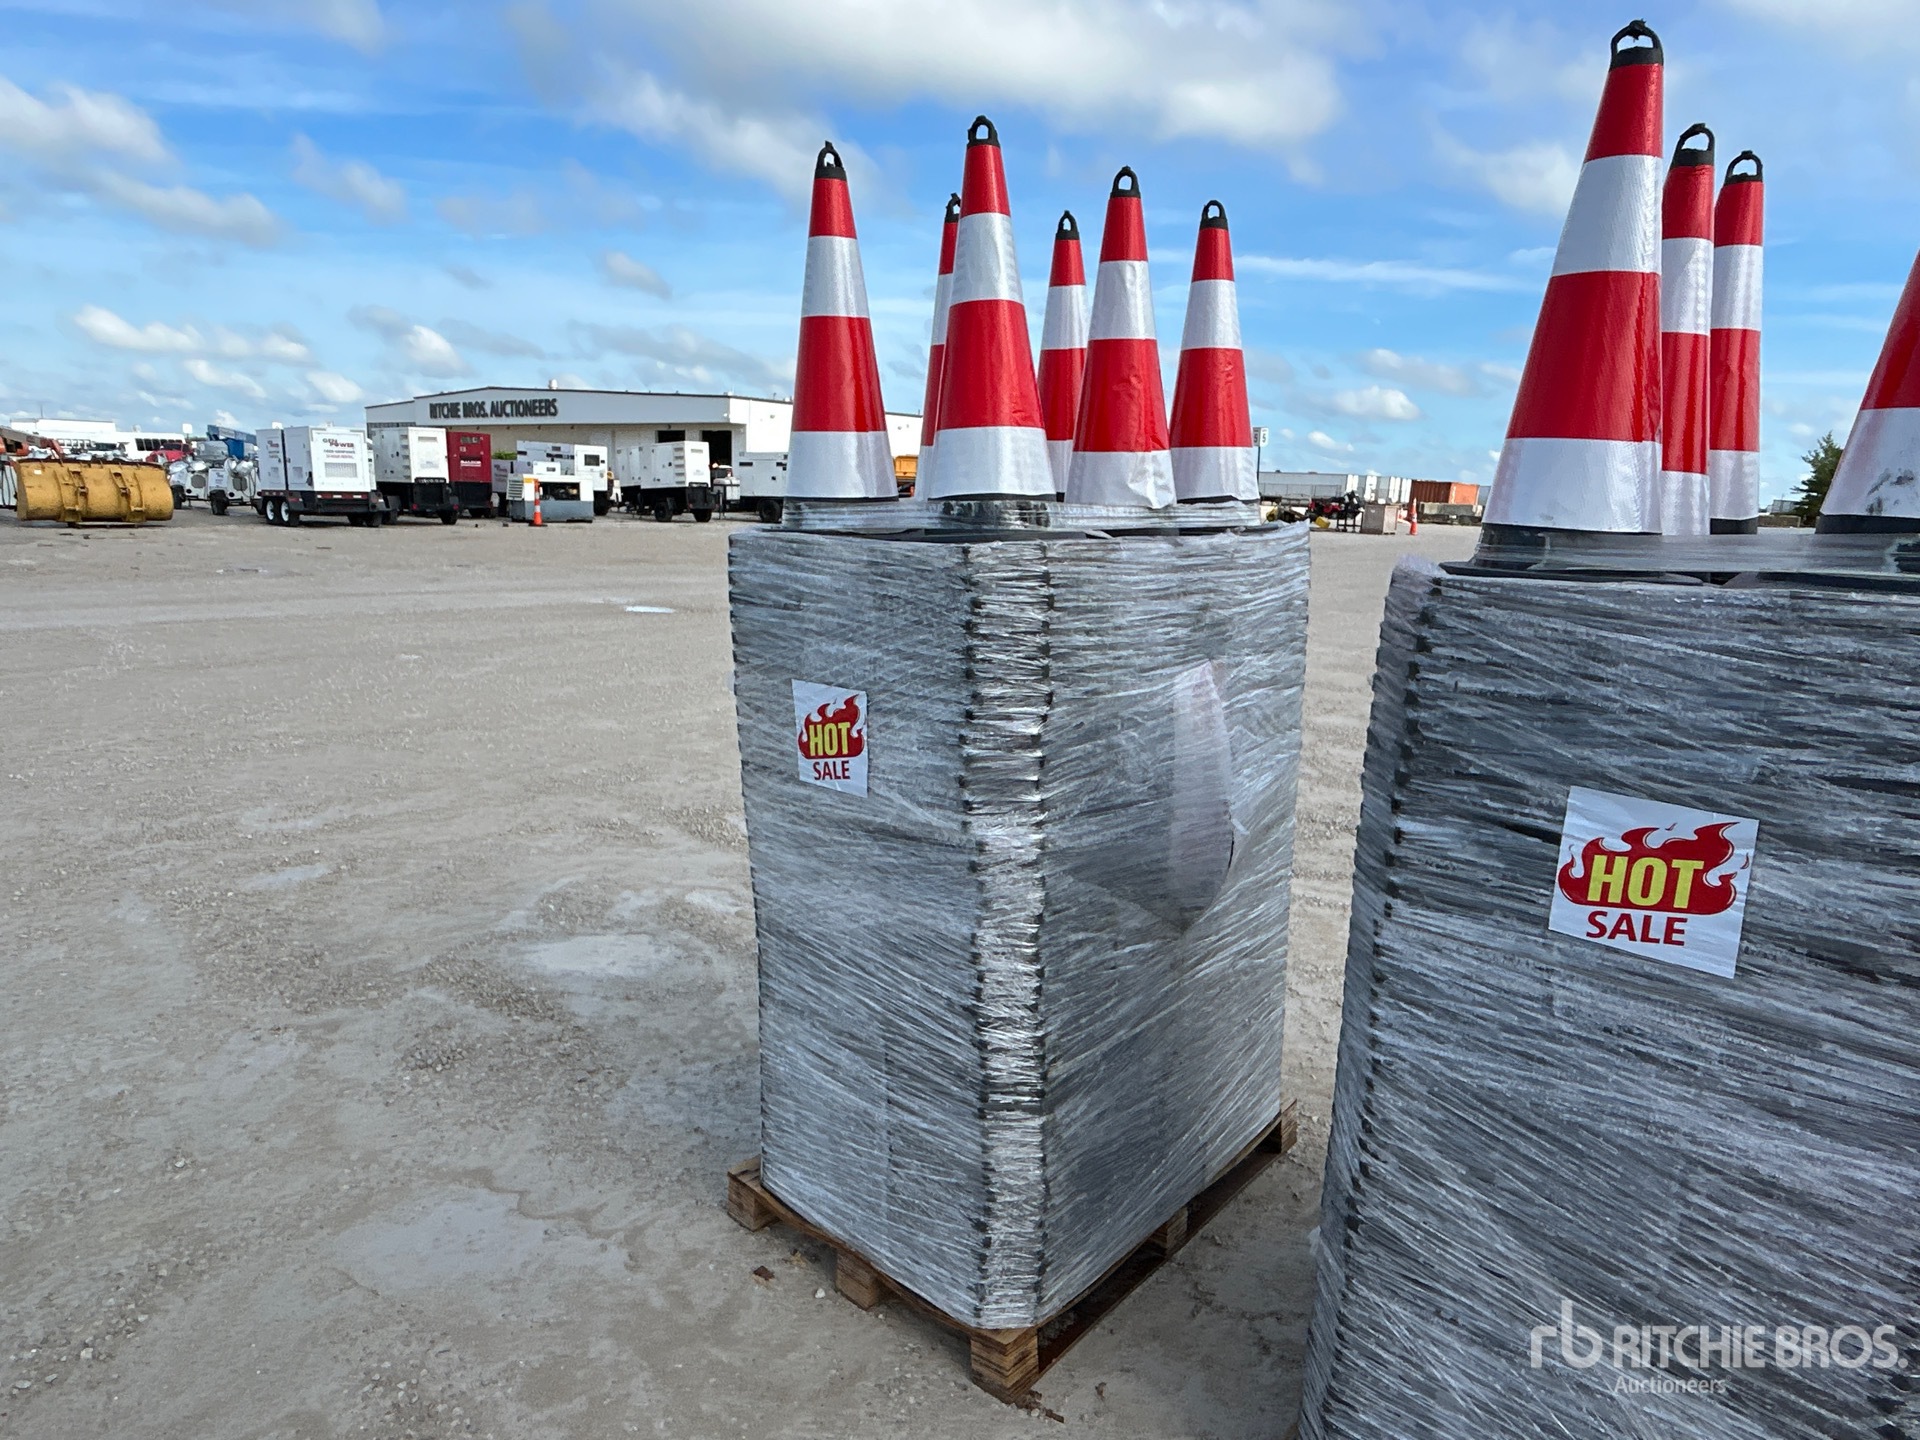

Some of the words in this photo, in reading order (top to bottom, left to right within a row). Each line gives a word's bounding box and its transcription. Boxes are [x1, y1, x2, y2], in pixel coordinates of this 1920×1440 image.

[429, 402, 461, 419] RITCHIE
[463, 401, 488, 418] BROS.
[490, 398, 558, 418] AUCTIONEERS
[808, 721, 851, 757] HOT
[812, 760, 851, 781] SALE
[1586, 854, 1705, 910] HOT
[1585, 910, 1689, 947] SALE
